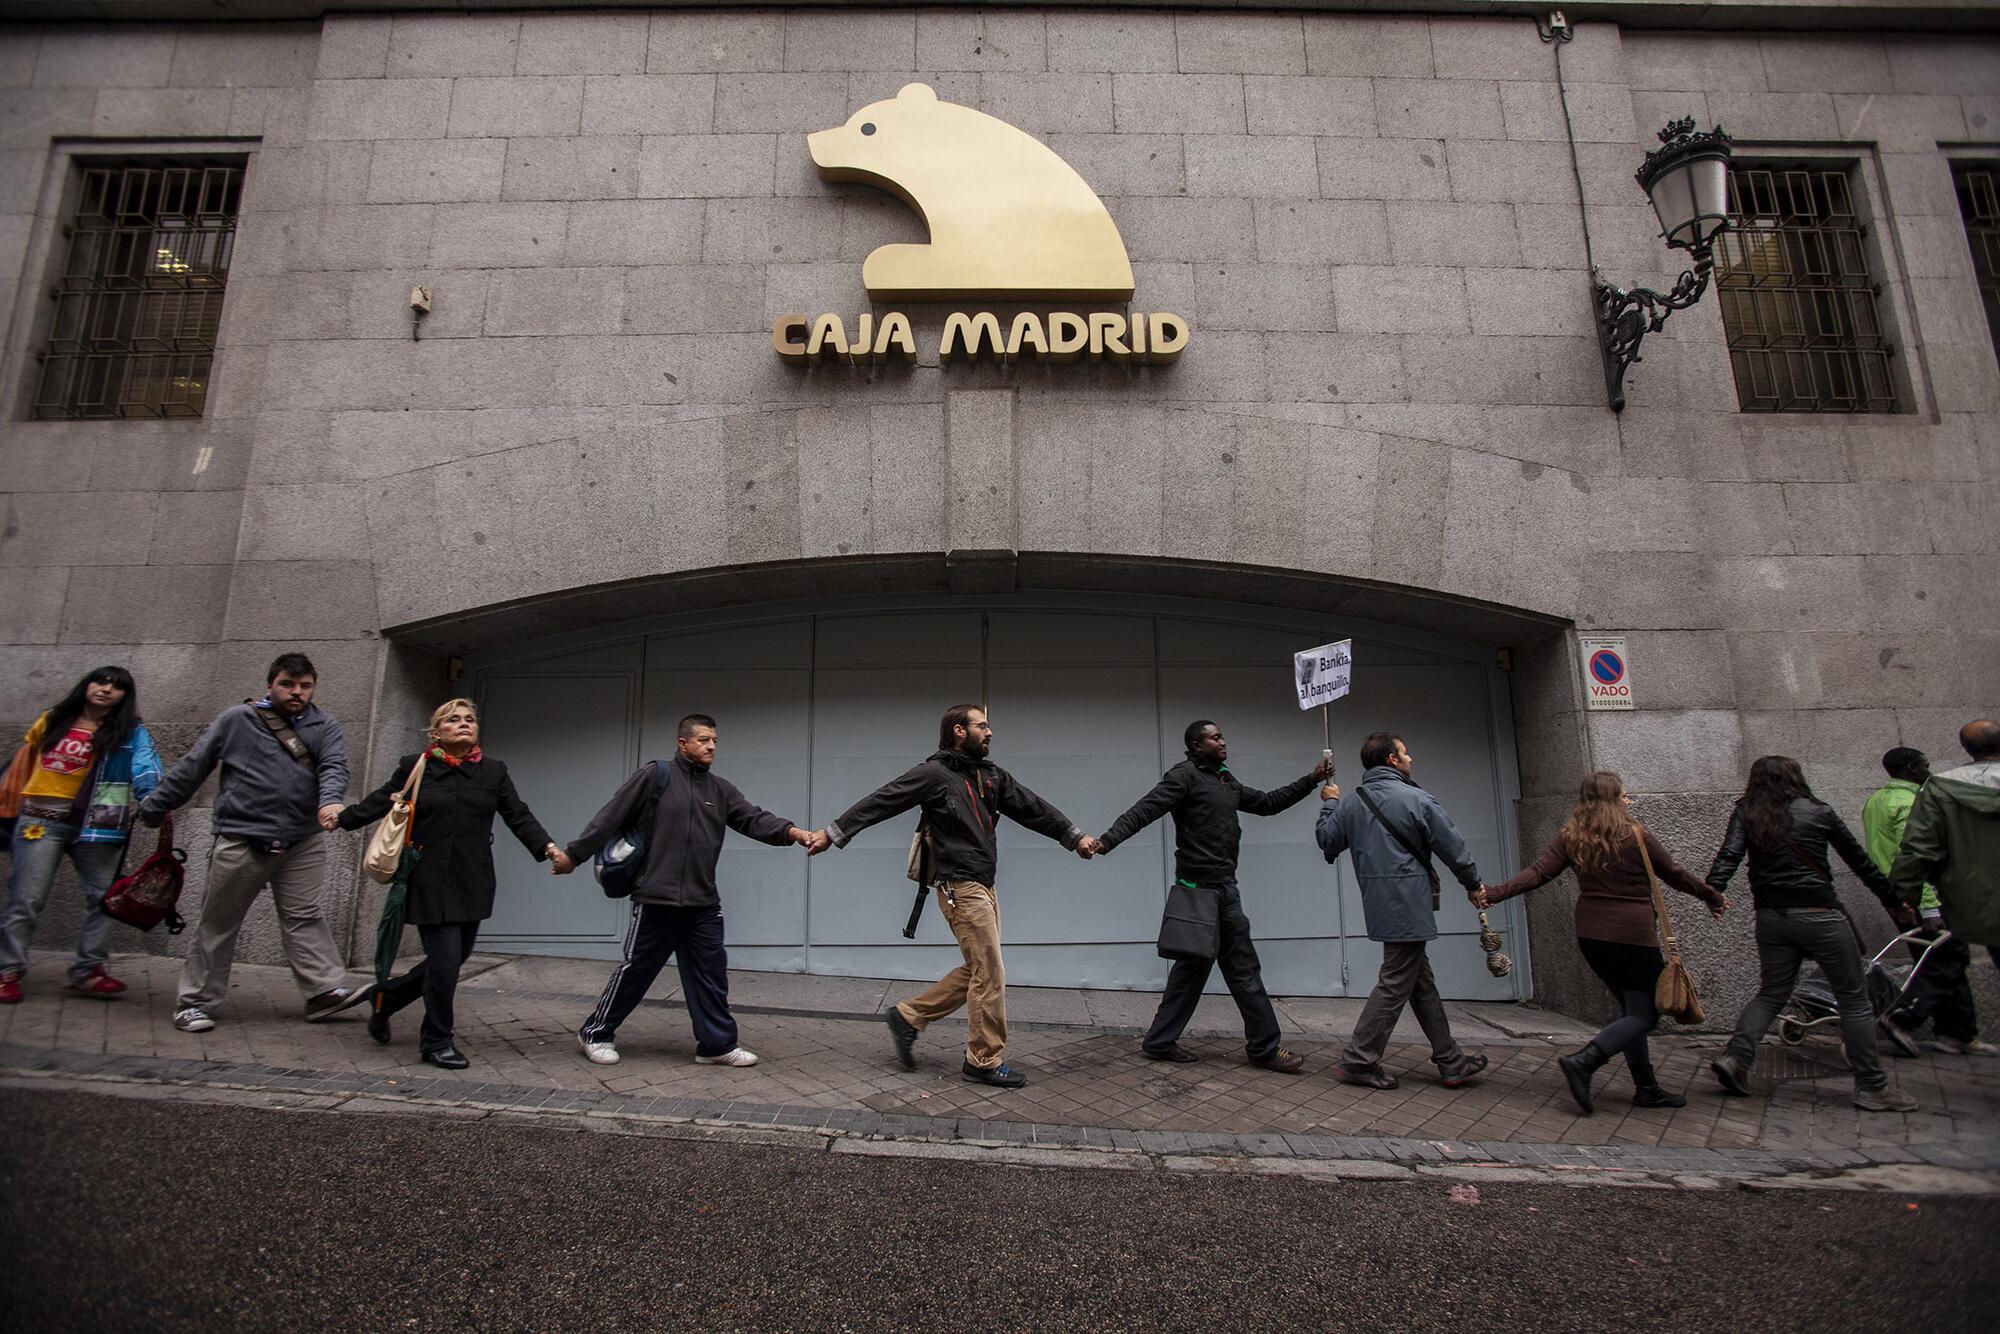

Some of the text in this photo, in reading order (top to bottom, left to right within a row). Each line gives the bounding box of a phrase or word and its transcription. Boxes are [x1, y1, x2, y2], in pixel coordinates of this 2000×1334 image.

[773, 312, 1191, 359] CAJA MADRID
[1300, 685, 1308, 699] al
[1591, 686, 1629, 696] VADO
[54, 739, 93, 756] TOP
